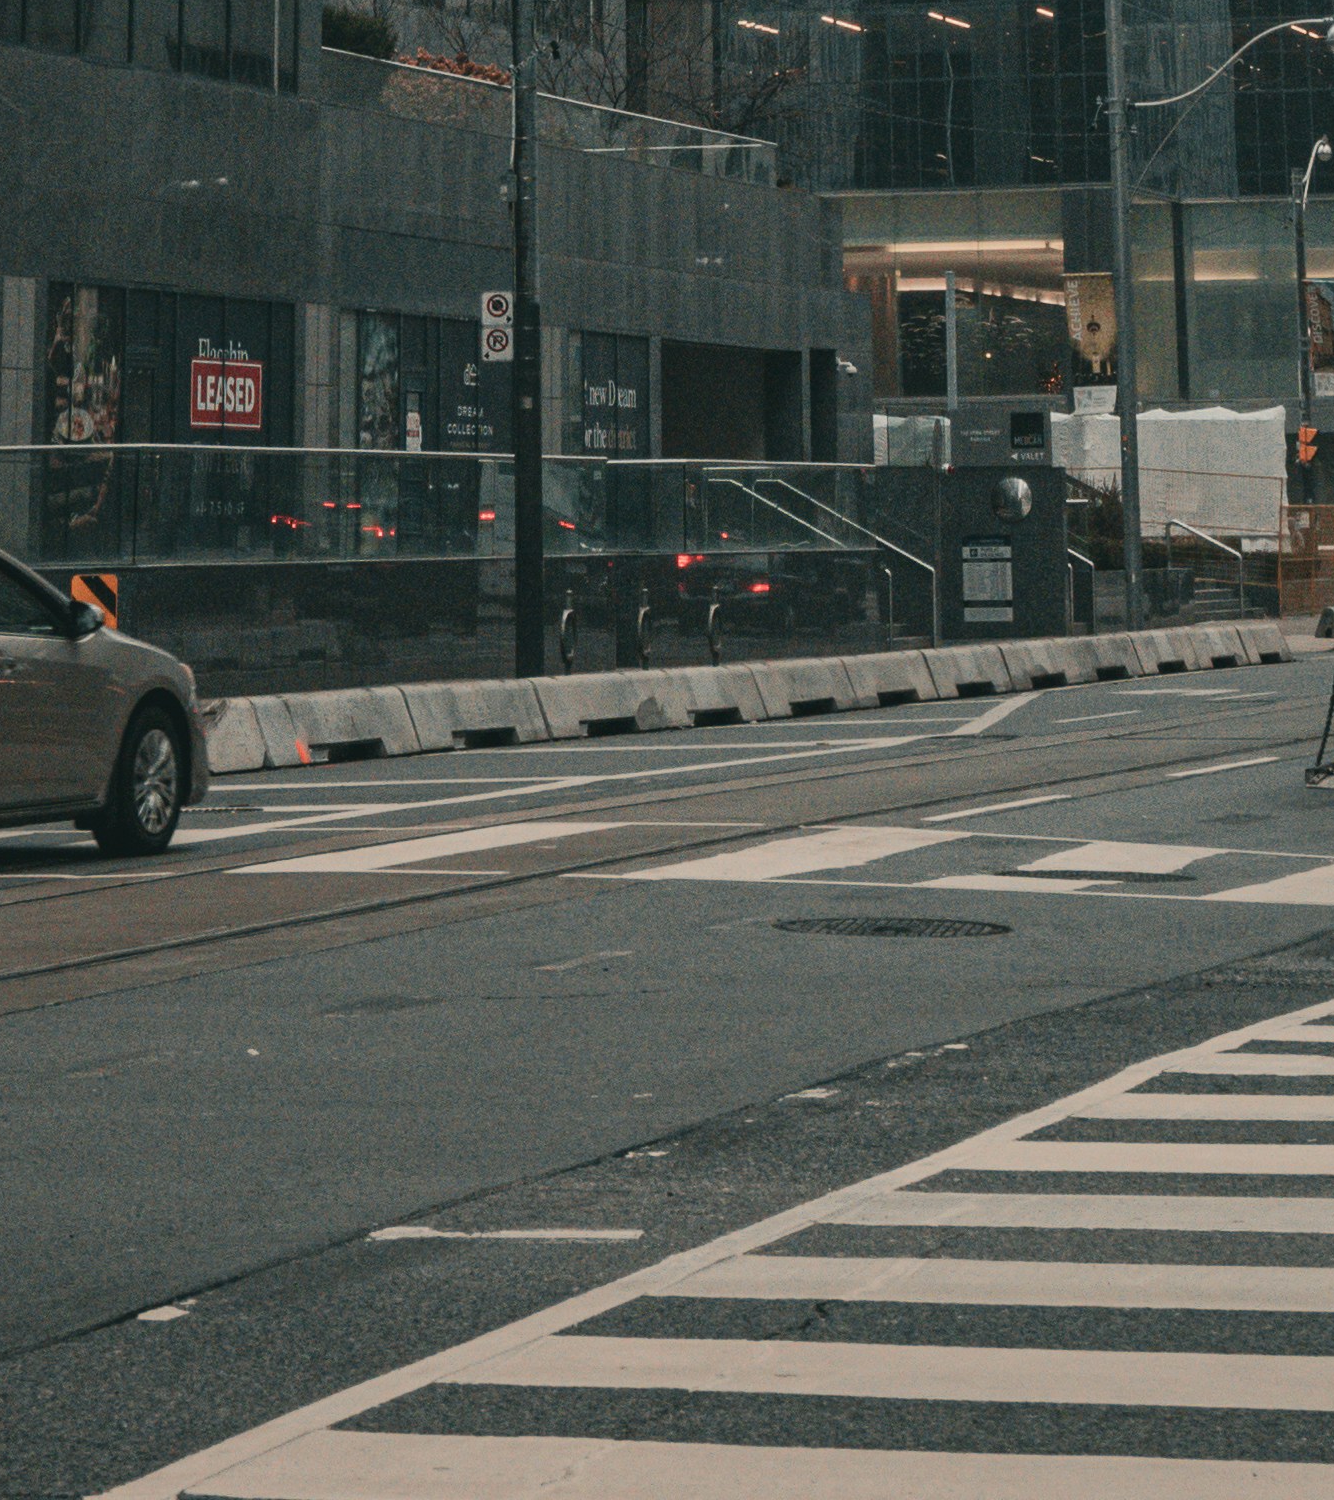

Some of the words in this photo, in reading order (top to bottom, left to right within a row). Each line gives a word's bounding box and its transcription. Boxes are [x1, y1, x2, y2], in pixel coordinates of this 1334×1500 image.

[1067, 280, 1082, 341] ACHIEVE
[196, 374, 256, 413] LEASED
[1020, 451, 1045, 461] VALET
